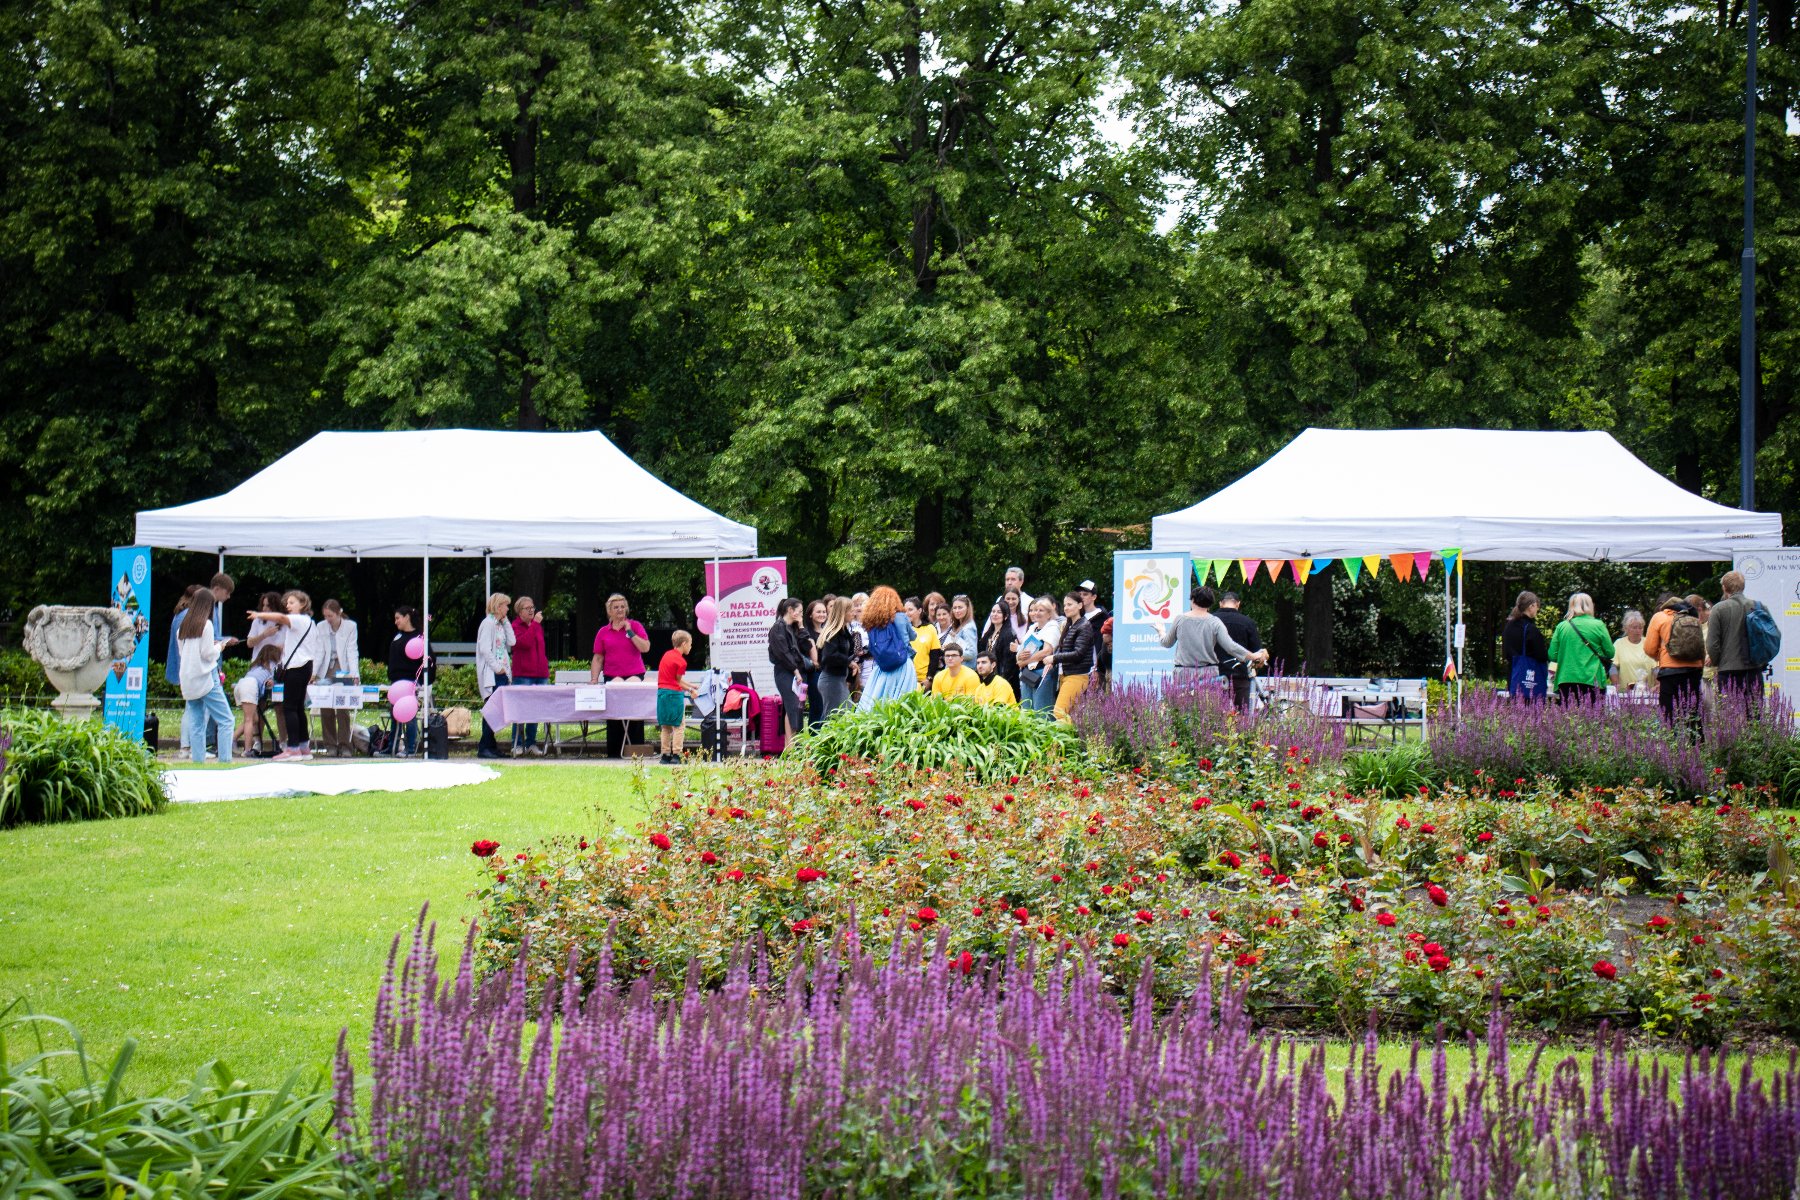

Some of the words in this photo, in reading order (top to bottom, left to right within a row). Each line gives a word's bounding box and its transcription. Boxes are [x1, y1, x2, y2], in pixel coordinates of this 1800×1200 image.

[730, 601, 765, 610] NASZA
[719, 607, 776, 619] ZIAŁALNOŚ
[1129, 633, 1160, 643] BILING
